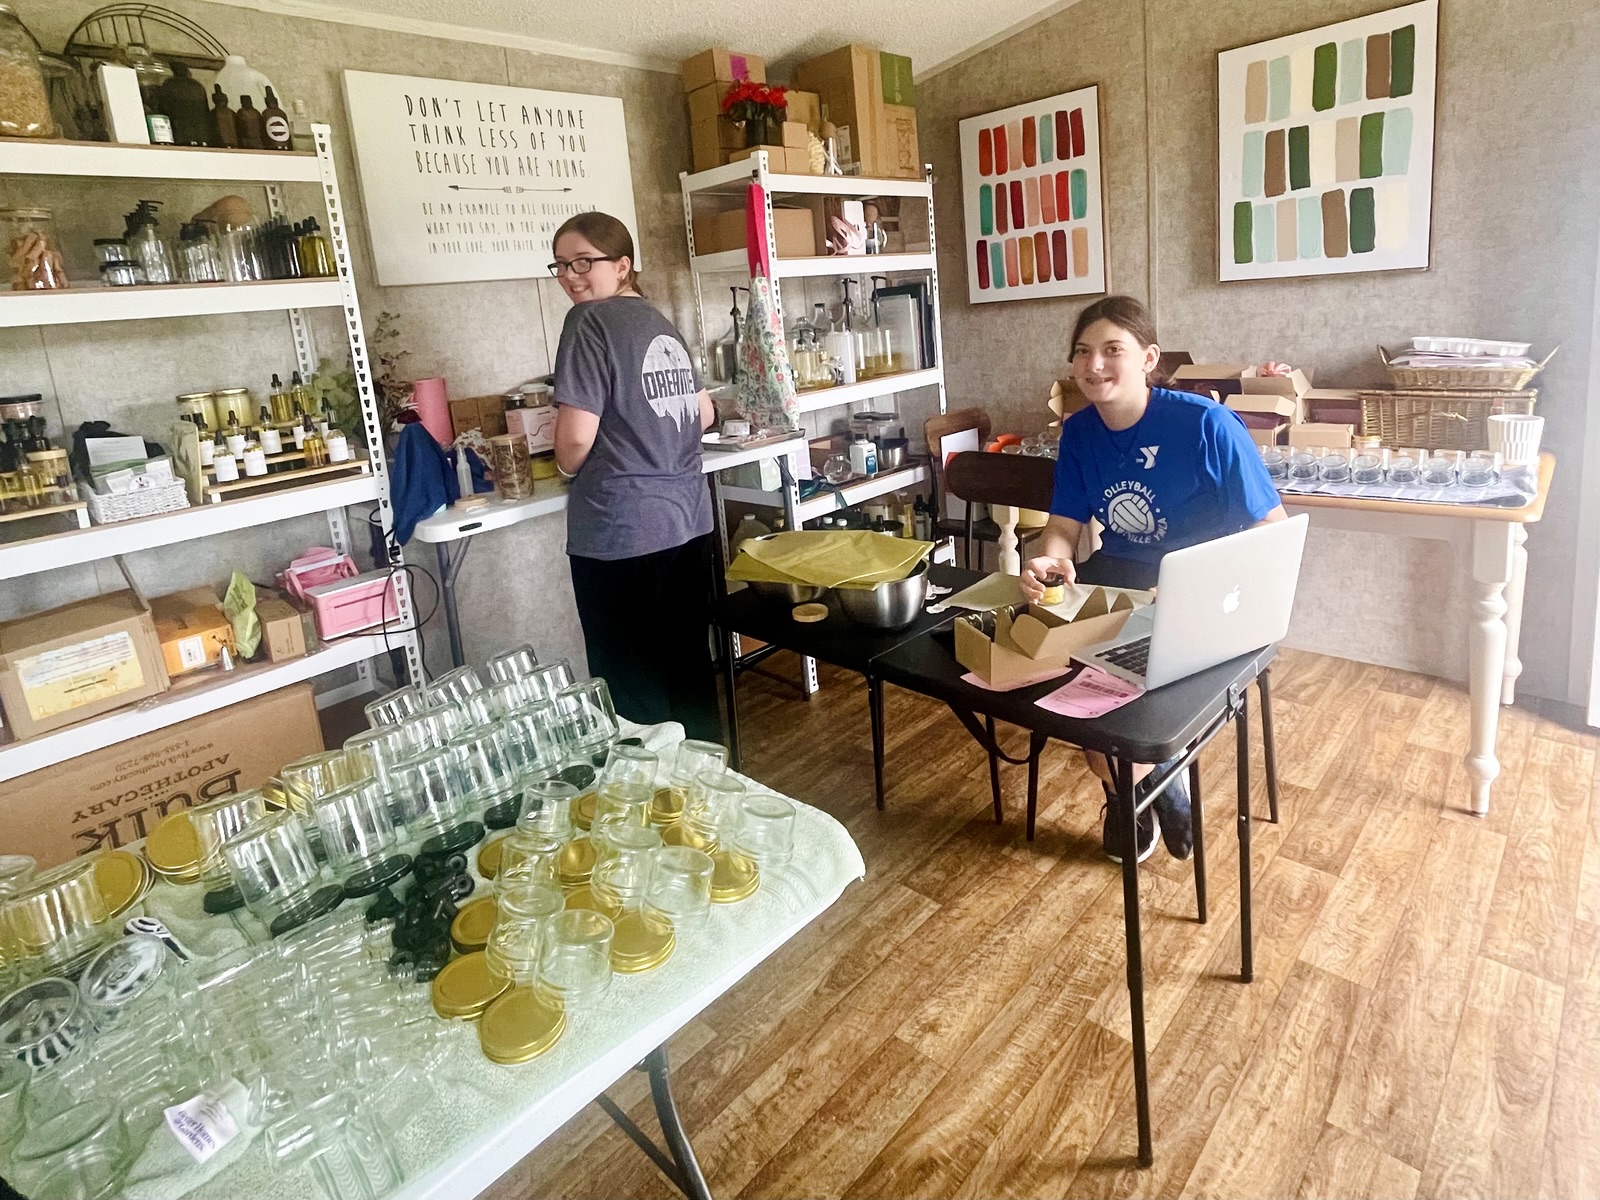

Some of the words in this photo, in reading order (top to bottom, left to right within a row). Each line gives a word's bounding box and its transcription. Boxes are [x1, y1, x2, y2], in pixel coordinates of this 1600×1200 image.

[405, 94, 462, 118] DON'T
[476, 100, 507, 122] LET
[521, 105, 585, 129] ANYONE
[408, 123, 466, 146] THINK
[478, 127, 518, 149] LESS
[530, 132, 546, 150] OF
[558, 134, 587, 153] YOU
[415, 150, 476, 175] BECAUSE
[485, 156, 510, 176] YOU
[517, 157, 540, 177] ARE
[422, 202, 433, 216] BE
[440, 202, 453, 216] AN
[459, 202, 501, 216] EXAMPLE
[505, 203, 516, 216] TO
[521, 203, 537, 216] ALL
[541, 203, 584, 215] BELIEVERS
[425, 222, 450, 235] WHAT
[456, 222, 474, 235] YOU
[506, 221, 515, 234] IN
[520, 221, 535, 234] THE
[540, 221, 556, 233] WAY
[428, 242, 438, 255] IN
[441, 241, 463, 254] YOUR
[491, 240, 510, 252] YOUR
[1103, 480, 1156, 504] OLLEYBALL
[72, 753, 230, 824] APOTHECARY
